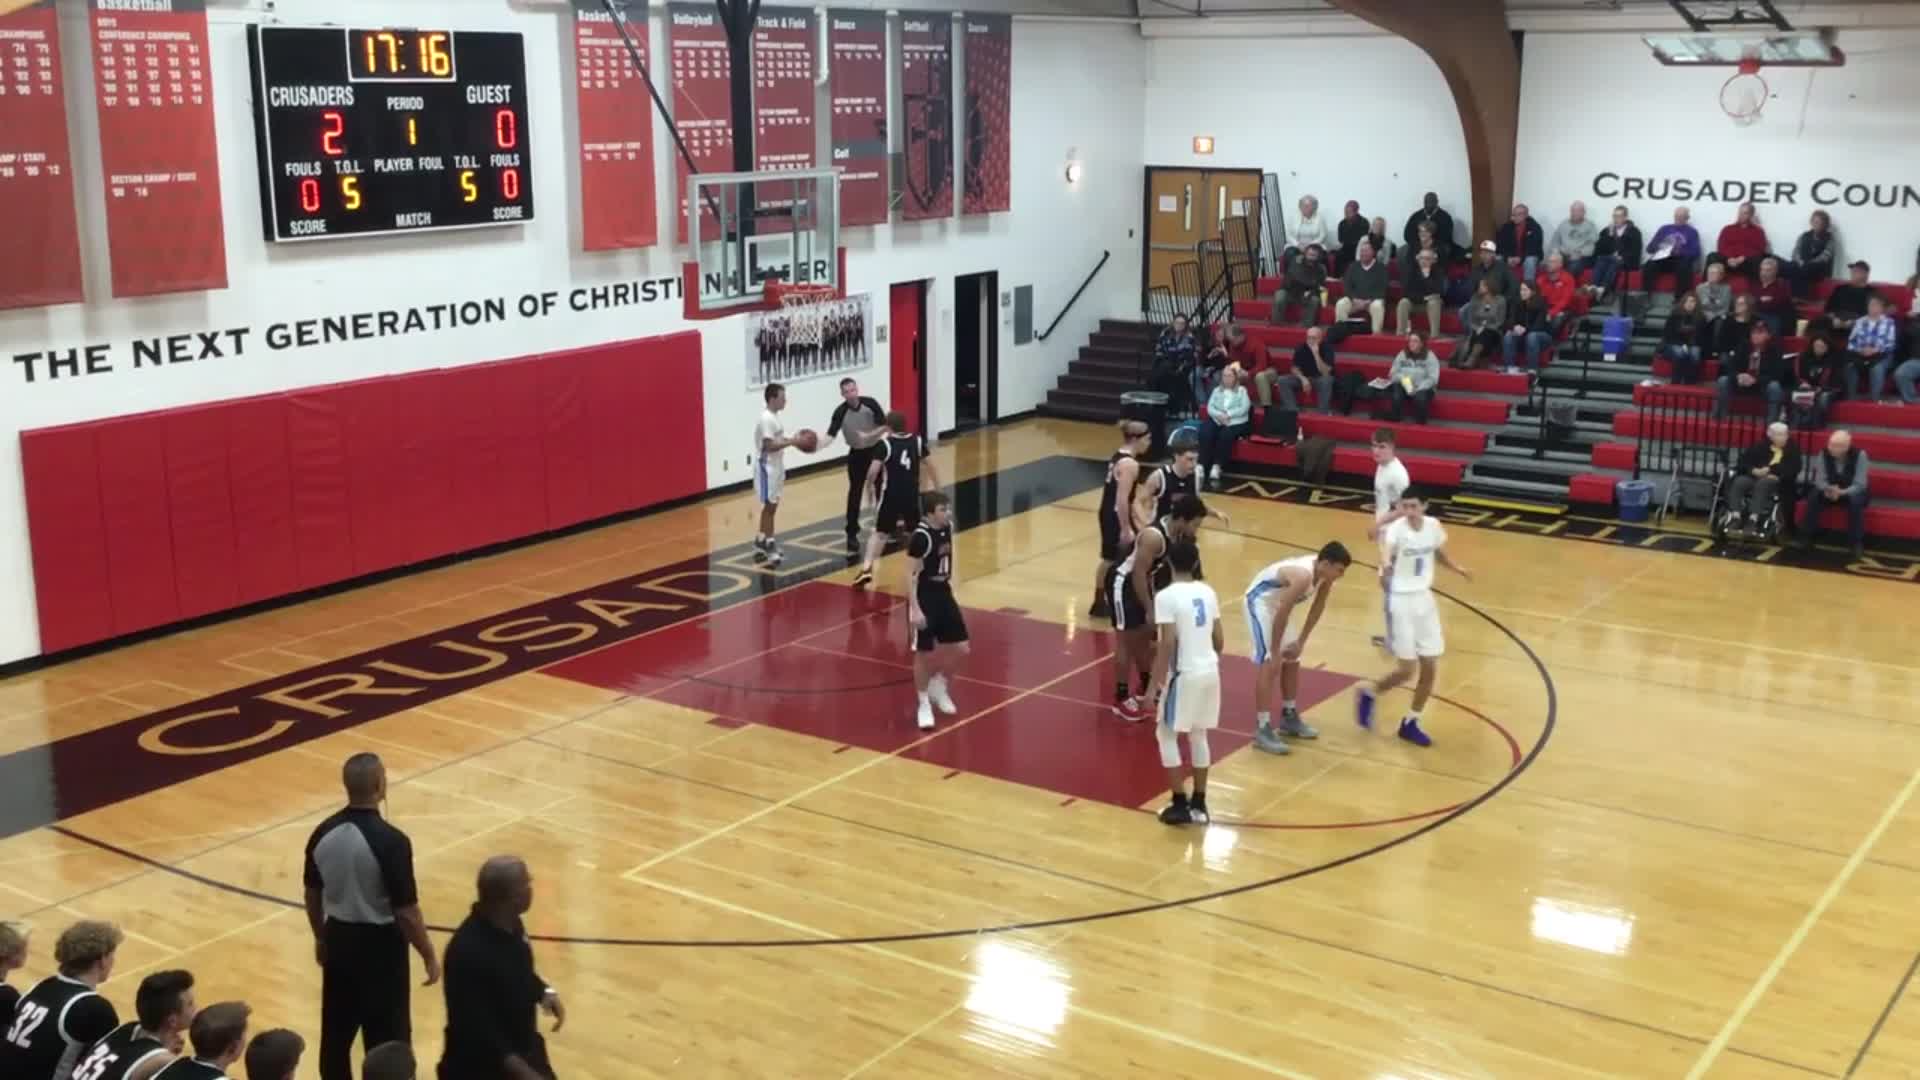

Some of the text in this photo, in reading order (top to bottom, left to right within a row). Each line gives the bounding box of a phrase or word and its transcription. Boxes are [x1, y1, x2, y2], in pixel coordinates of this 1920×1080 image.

[756, 16, 778, 28] Track
[366, 32, 451, 76] 17:16
[270, 86, 354, 107] CRUSADERS
[387, 97, 424, 110] PERIOD
[466, 85, 512, 104] GUEST
[323, 112, 344, 154] 2
[408, 118, 418, 145] 1
[496, 109, 516, 148] 0
[285, 153, 520, 176] FOULS T.O.L. PLAYER FOUL T.O.L. FOULS
[301, 169, 519, 212] 0 5 5 0
[1592, 172, 1920, 209] CRUSADER COUN
[290, 206, 522, 234] SCORE MATCH SCORE
[13, 344, 113, 383] THE
[132, 327, 250, 369] NEXT
[265, 297, 506, 351] GENERATION
[518, 291, 559, 318] OF
[568, 272, 723, 313] CHRISTIN
[900, 450, 912, 470] 4
[1192, 598, 1206, 627] 3
[138, 517, 878, 756] CRUSADER
[7, 1001, 49, 1048] 32
